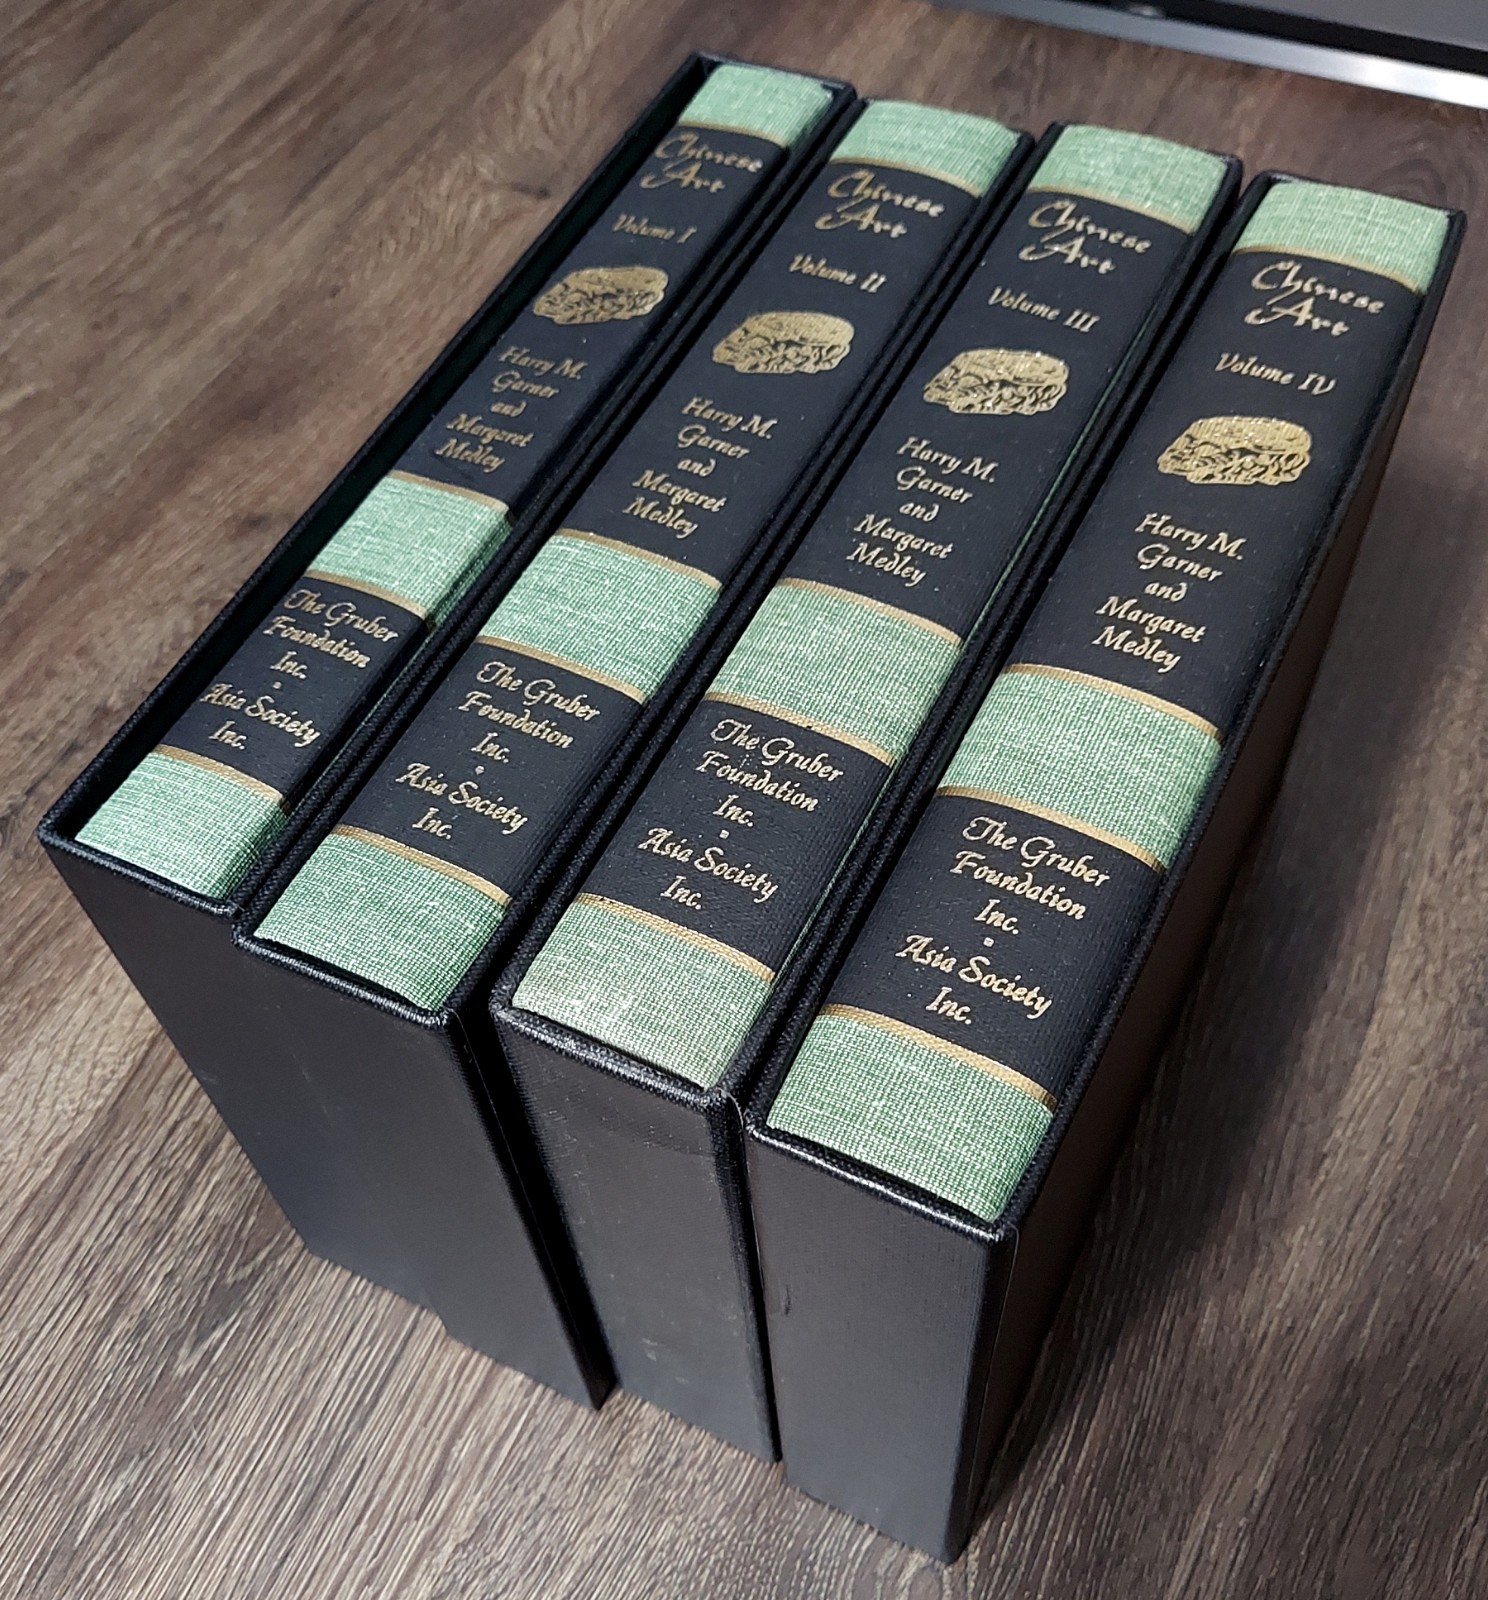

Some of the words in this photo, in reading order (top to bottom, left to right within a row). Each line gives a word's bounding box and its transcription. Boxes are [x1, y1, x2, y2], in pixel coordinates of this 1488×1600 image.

[655, 133, 764, 173] Chinese
[640, 163, 727, 193] Art
[827, 169, 945, 217] Chinese
[612, 213, 675, 241] Volume
[676, 225, 697, 244] I
[815, 203, 907, 238] Art
[1027, 199, 1153, 254] Chinese
[789, 254, 857, 286] Volume
[860, 273, 887, 293] II
[1018, 234, 1117, 275] Art
[1251, 259, 1386, 315] Chinese
[988, 286, 1061, 321] Volume
[1063, 308, 1101, 333] III
[1244, 298, 1351, 337] Art
[498, 345, 555, 376] Harry
[553, 358, 583, 379] M.
[1214, 352, 1295, 385] Volume
[1298, 373, 1337, 395] IV
[491, 371, 560, 399] Garner
[490, 401, 526, 418] and
[682, 397, 742, 431] Harry
[740, 415, 778, 438] M.
[445, 412, 535, 449] Margaret
[677, 425, 750, 459] Garner
[434, 438, 506, 472] Medley
[677, 458, 716, 476] and
[897, 436, 961, 473] Harry
[961, 457, 1000, 483] M.
[632, 469, 728, 513] Margaret
[896, 465, 973, 503] Garner
[623, 496, 699, 539] Medley
[899, 500, 939, 522] and
[854, 514, 955, 559] Margaret
[1135, 513, 1206, 552] Harry
[1207, 532, 1247, 560] M.
[846, 542, 928, 586] Medley
[1136, 543, 1225, 582] Garner
[1145, 580, 1188, 603] and
[283, 589, 323, 617] The
[323, 600, 400, 643] Gruber
[1096, 596, 1206, 644] Margaret
[263, 614, 372, 669] Foundation
[1092, 625, 1182, 673] Medley
[270, 650, 308, 680] Inc.
[475, 660, 523, 692] The
[523, 678, 602, 723] Gruber
[199, 682, 244, 712] Asia
[244, 694, 322, 748] Society
[207, 719, 246, 751] Inc.
[458, 690, 575, 750] Foundation
[470, 731, 510, 764] Inc.
[710, 717, 760, 752] The
[760, 736, 845, 783] Gruber
[395, 762, 445, 797] Asia
[445, 779, 529, 835] Society
[695, 750, 821, 813] Foundation
[411, 806, 454, 840] Inc.
[712, 794, 755, 829] Inc.
[638, 827, 694, 864] Asia
[693, 846, 780, 904] Society
[961, 815, 1018, 850] The
[1018, 835, 1112, 888] Gruber
[660, 874, 704, 911] Inc.
[950, 850, 1087, 921] Foundation
[973, 900, 1021, 935] Inc.
[895, 934, 957, 974] Asia
[957, 952, 1055, 1021] Society
[925, 986, 973, 1026] Inc.
